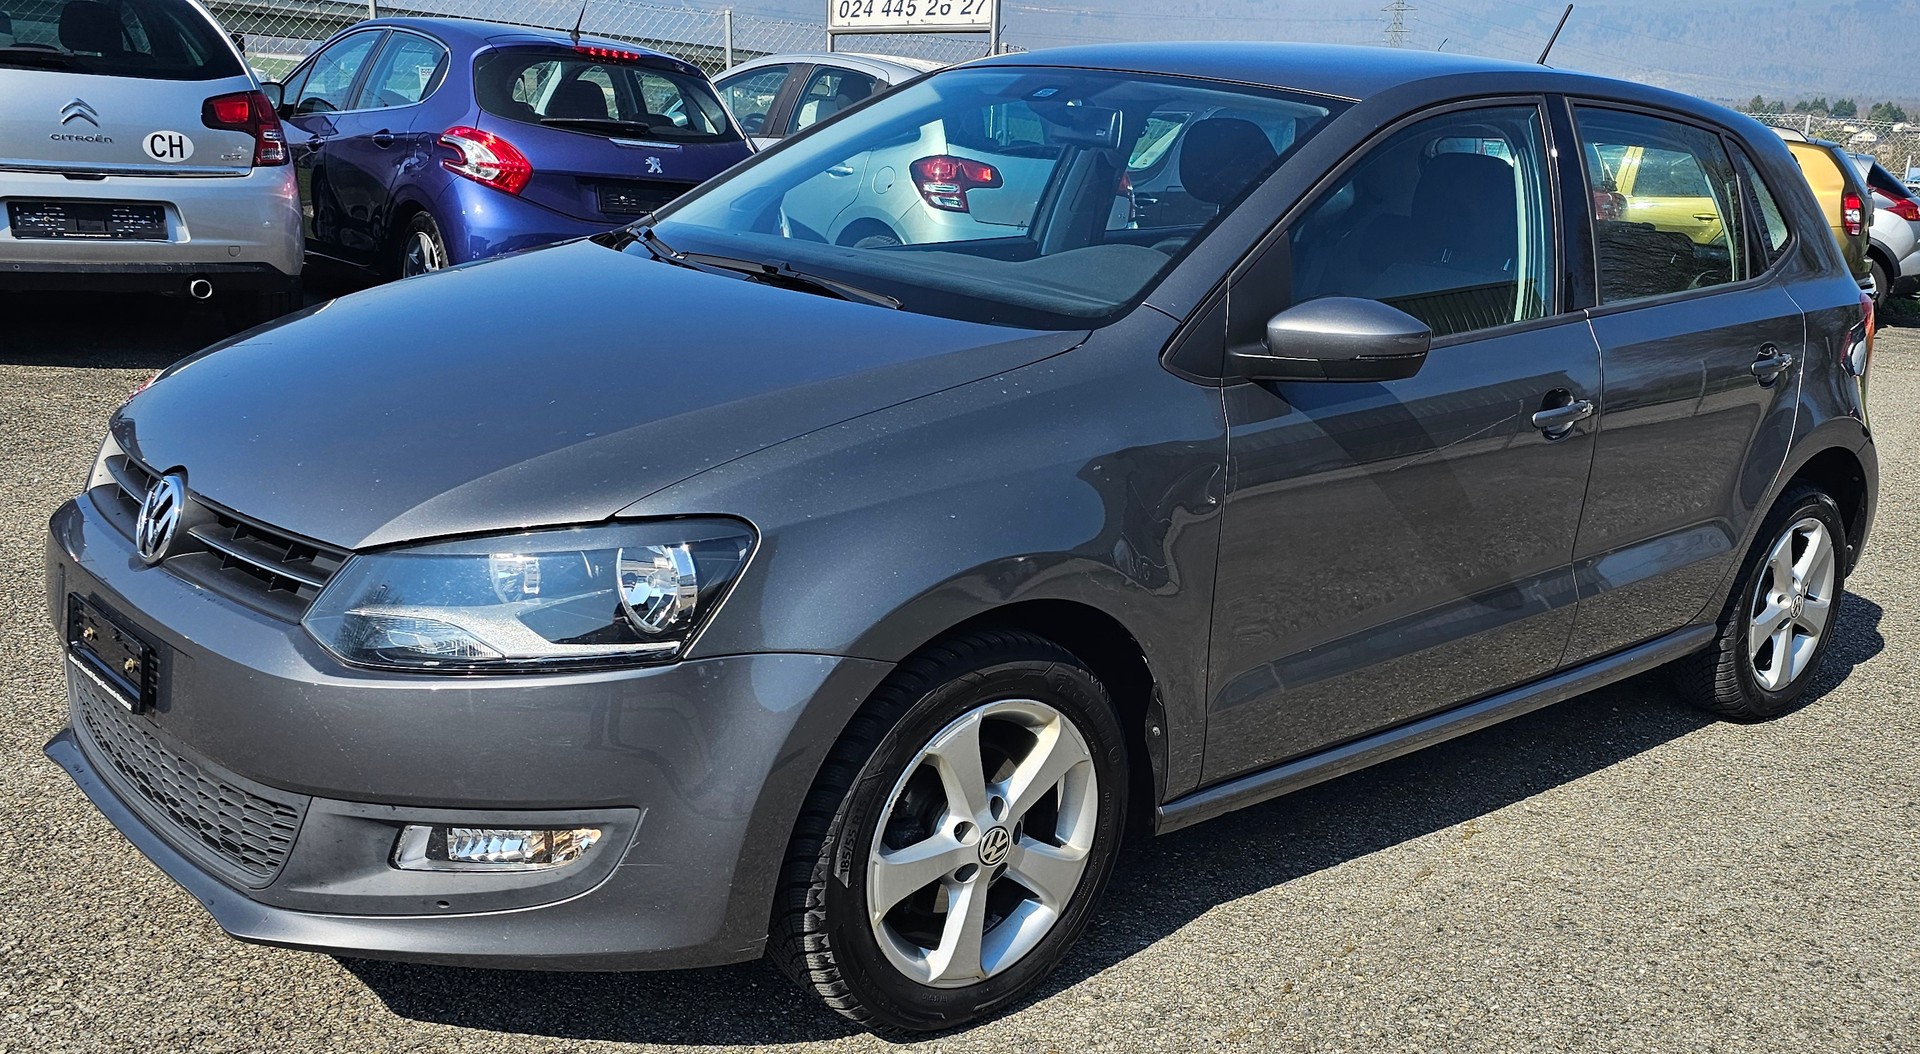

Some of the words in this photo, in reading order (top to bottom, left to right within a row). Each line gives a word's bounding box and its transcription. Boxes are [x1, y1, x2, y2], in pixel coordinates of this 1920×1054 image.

[839, 0, 873, 18] 024
[881, 0, 917, 17] 445
[925, 0, 952, 16] 26
[960, 0, 986, 15] 27
[150, 134, 184, 159] CH
[840, 829, 857, 875] 185/55
